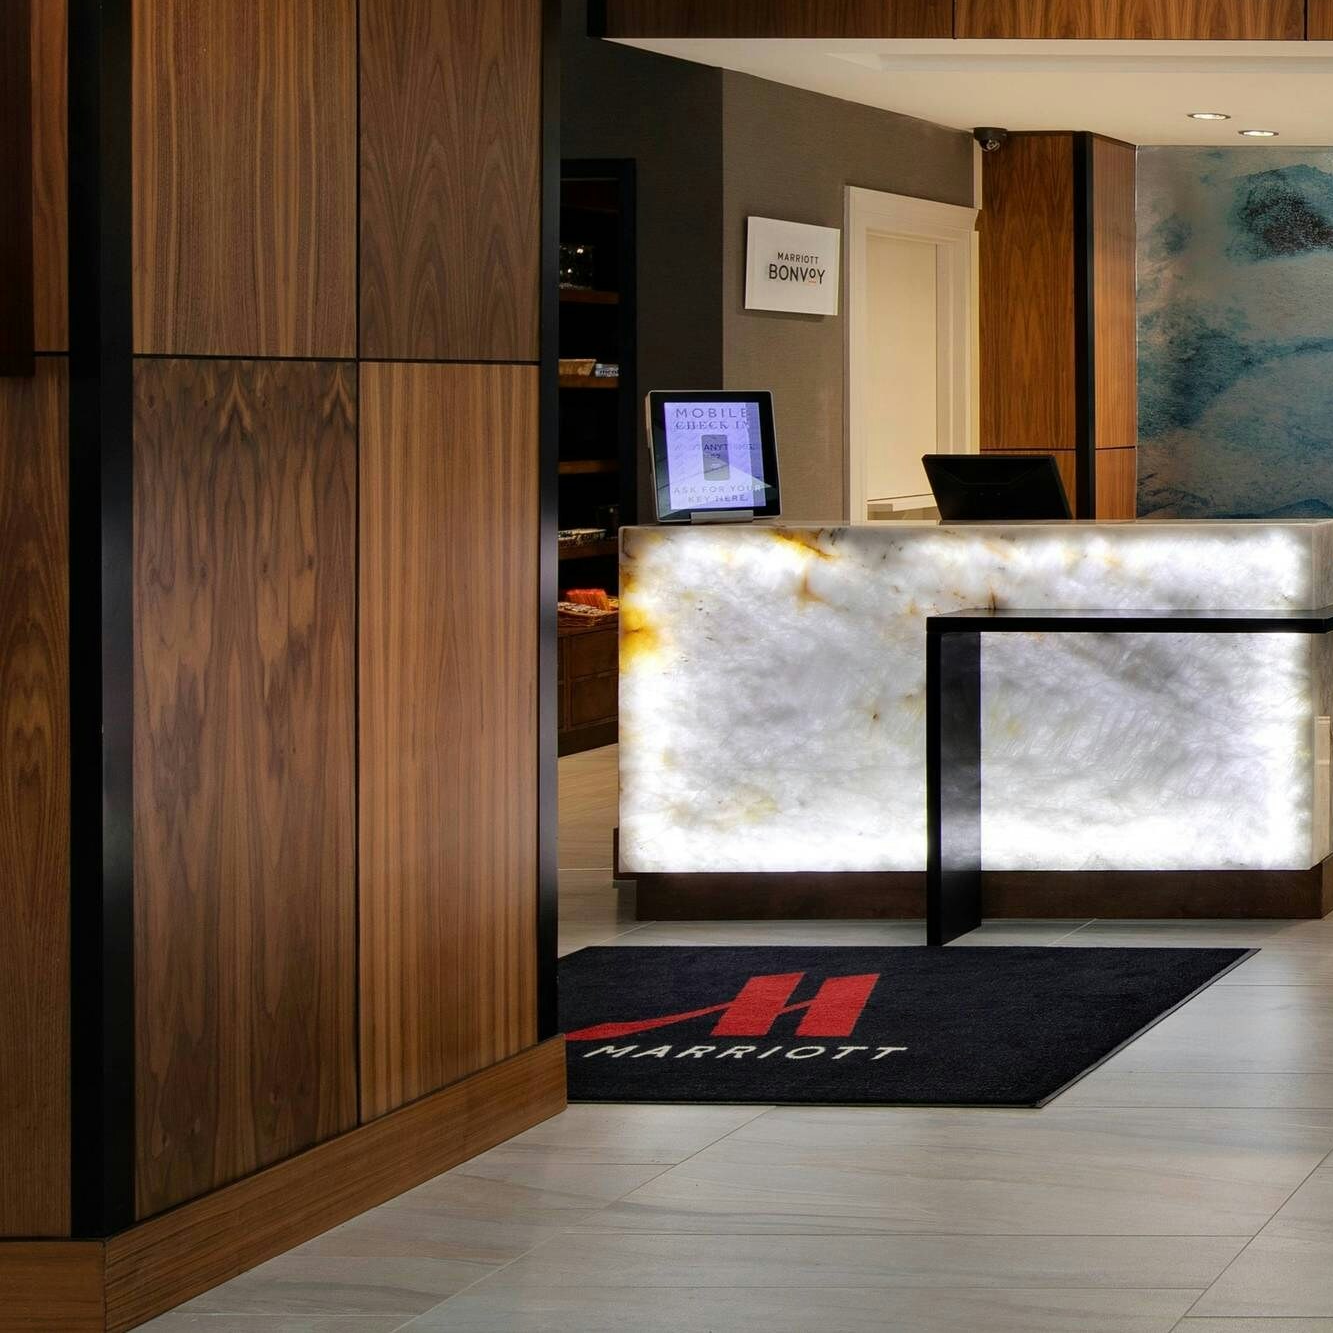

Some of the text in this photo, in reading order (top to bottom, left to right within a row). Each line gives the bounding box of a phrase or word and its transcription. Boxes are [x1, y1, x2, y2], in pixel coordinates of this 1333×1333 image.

[777, 252, 820, 265] MARRIOTT
[768, 263, 826, 285] BONVOY
[675, 408, 750, 419] MOBILE
[675, 420, 729, 430] CHECK
[702, 485, 725, 493] FOR
[583, 1044, 908, 1060] MARRIOTT
